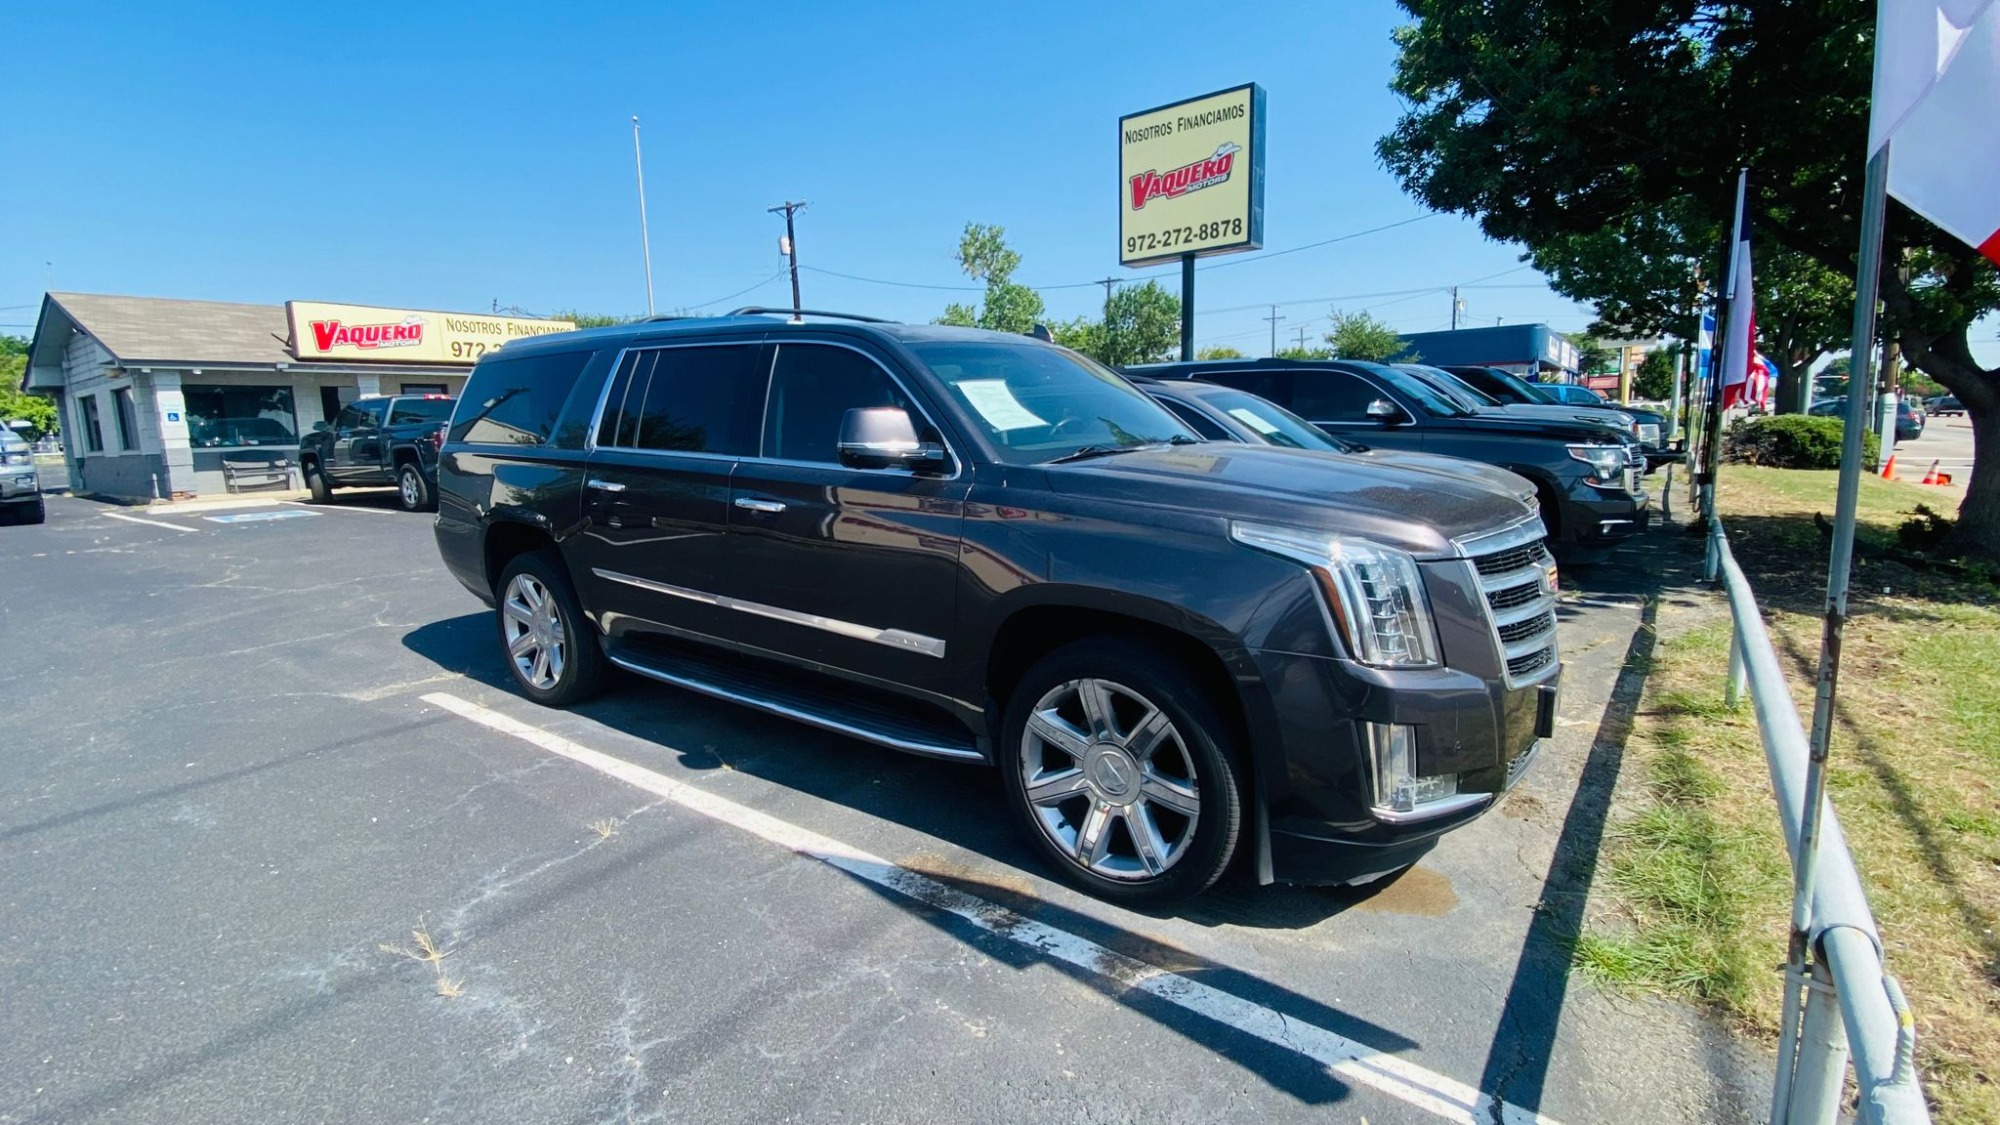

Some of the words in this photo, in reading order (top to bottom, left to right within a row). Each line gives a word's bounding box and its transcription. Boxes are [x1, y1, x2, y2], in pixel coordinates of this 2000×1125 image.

[1125, 121, 1173, 144] NOSOTROS
[1177, 104, 1245, 132] FINANCIAMOS
[1131, 151, 1235, 210] VAQUERO
[1188, 173, 1228, 192] MOTORS
[1127, 217, 1242, 252] 972-272-8878
[311, 320, 423, 351] VAQUERO
[446, 317, 502, 335] NOSOTROS
